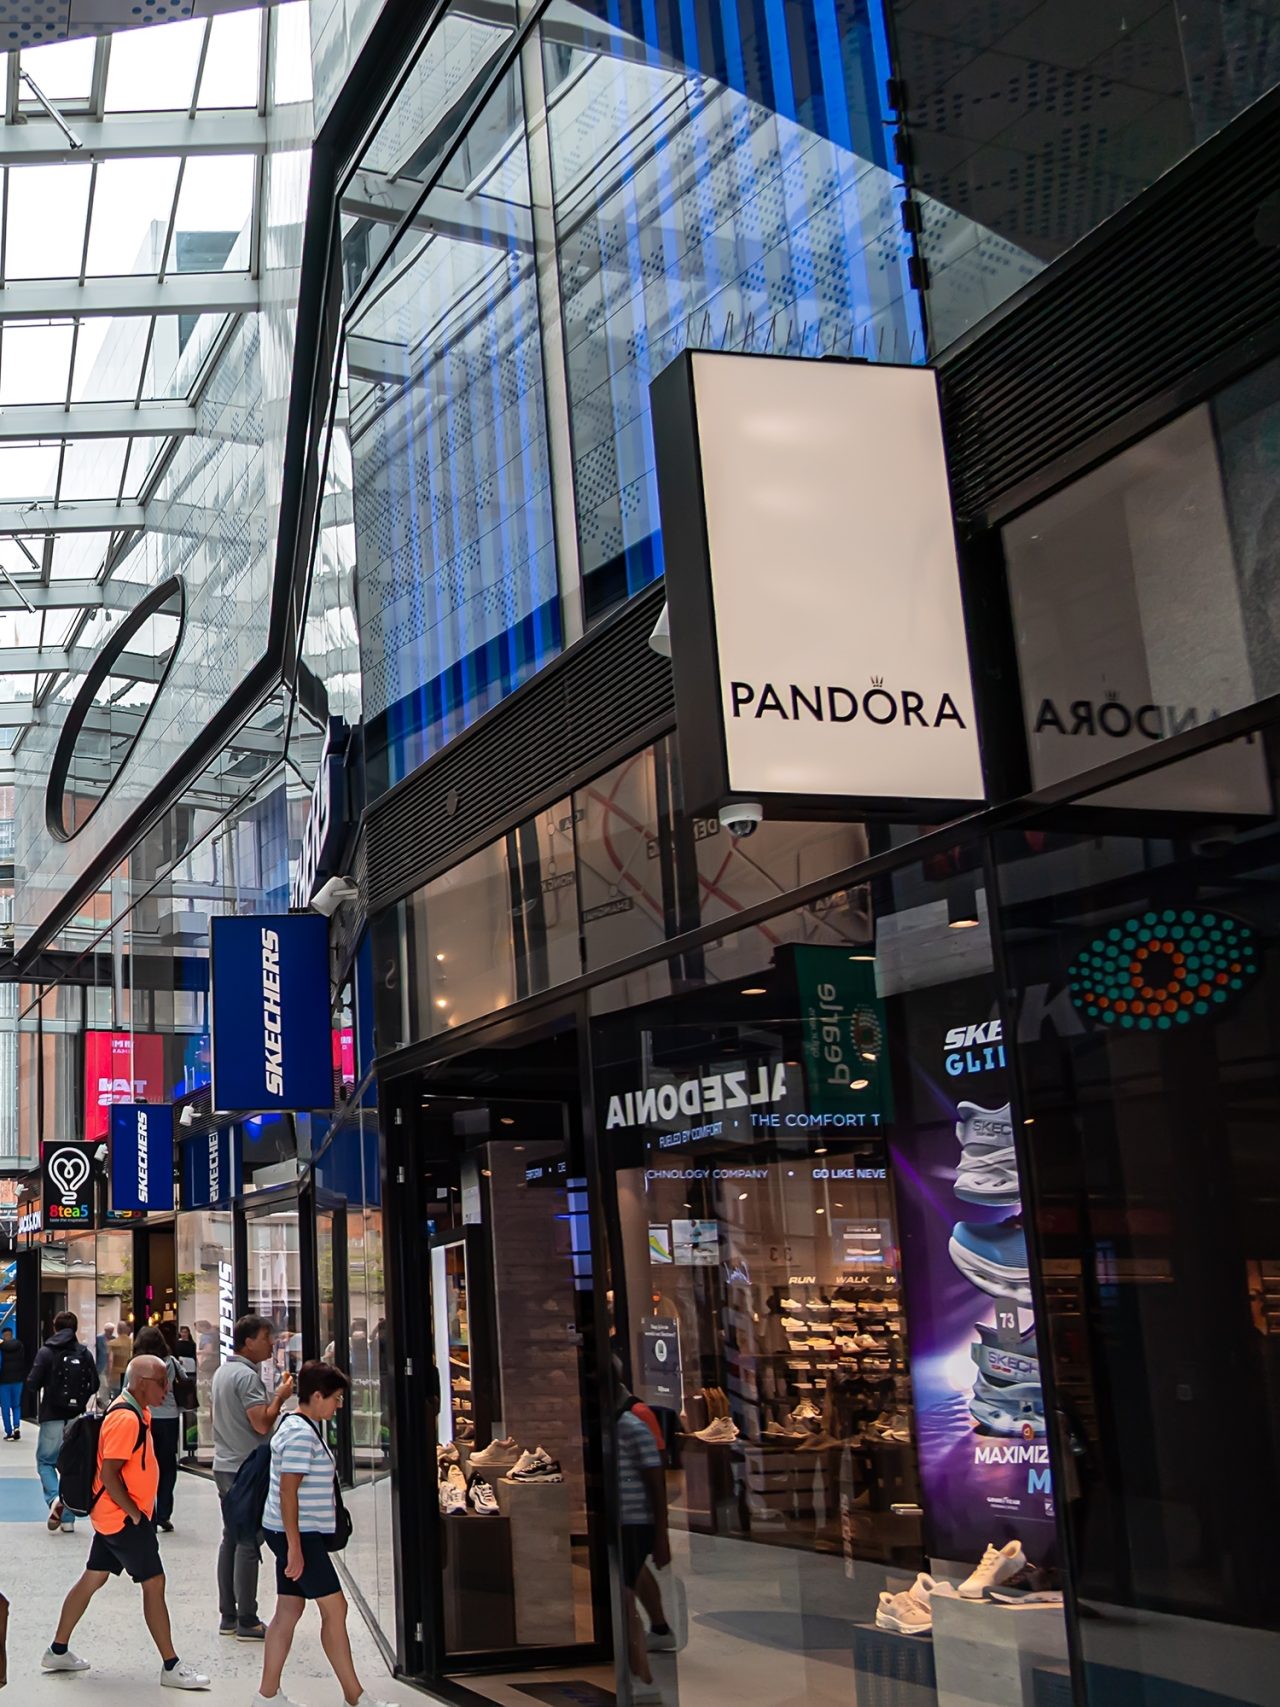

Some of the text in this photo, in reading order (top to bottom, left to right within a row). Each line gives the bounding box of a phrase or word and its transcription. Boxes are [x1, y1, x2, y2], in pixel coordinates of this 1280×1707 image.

[730, 681, 967, 730] PANDORA
[261, 927, 283, 1097] SKECHERS
[945, 1045, 1006, 1077] GLI
[750, 1113, 780, 1127] THE
[784, 1113, 866, 1128] COMFORT
[137, 1110, 149, 1204] SKECHERS
[712, 1169, 769, 1179] COMPANY
[831, 1168, 855, 1178] LIKE
[49, 1204, 89, 1218] 8tea5
[788, 1276, 817, 1285] RUN
[835, 1276, 870, 1284] WALK
[218, 1260, 236, 1367] SKECH
[998, 1312, 1015, 1330] 73
